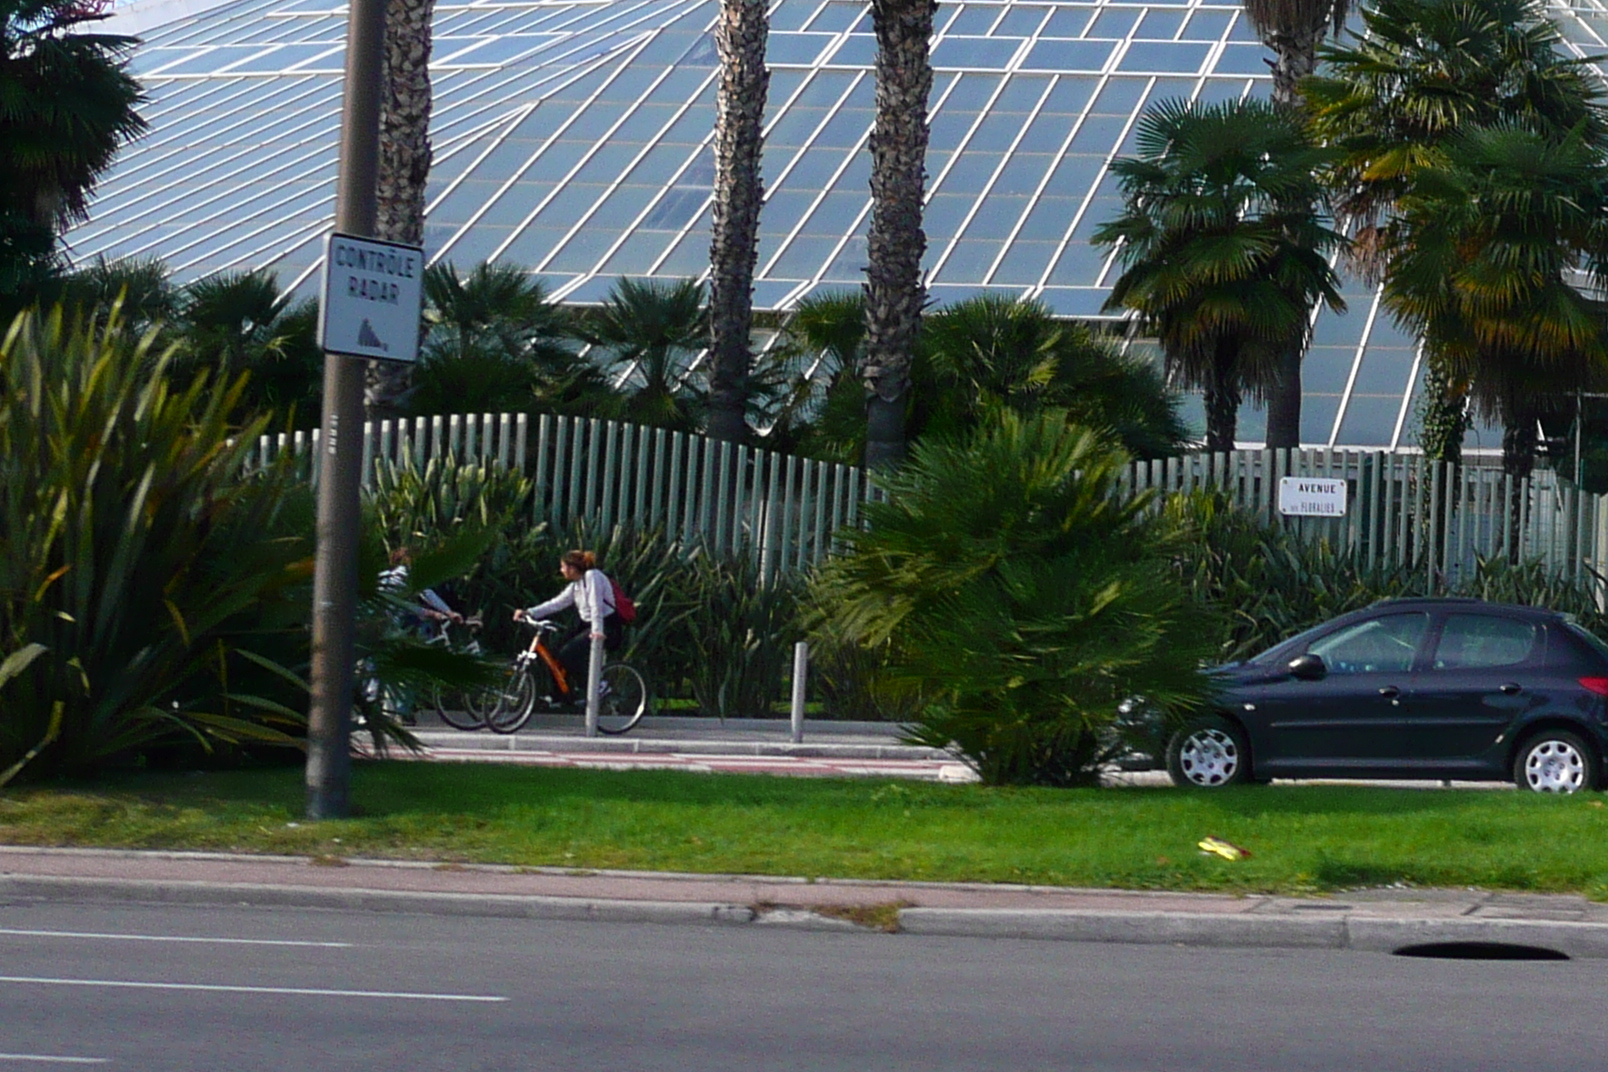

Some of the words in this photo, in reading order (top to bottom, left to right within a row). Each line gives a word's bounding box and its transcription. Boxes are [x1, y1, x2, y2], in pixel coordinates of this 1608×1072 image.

[335, 245, 415, 278] CONTRÔLE
[348, 276, 399, 306] RADAR
[1298, 483, 1336, 494] AVENUE
